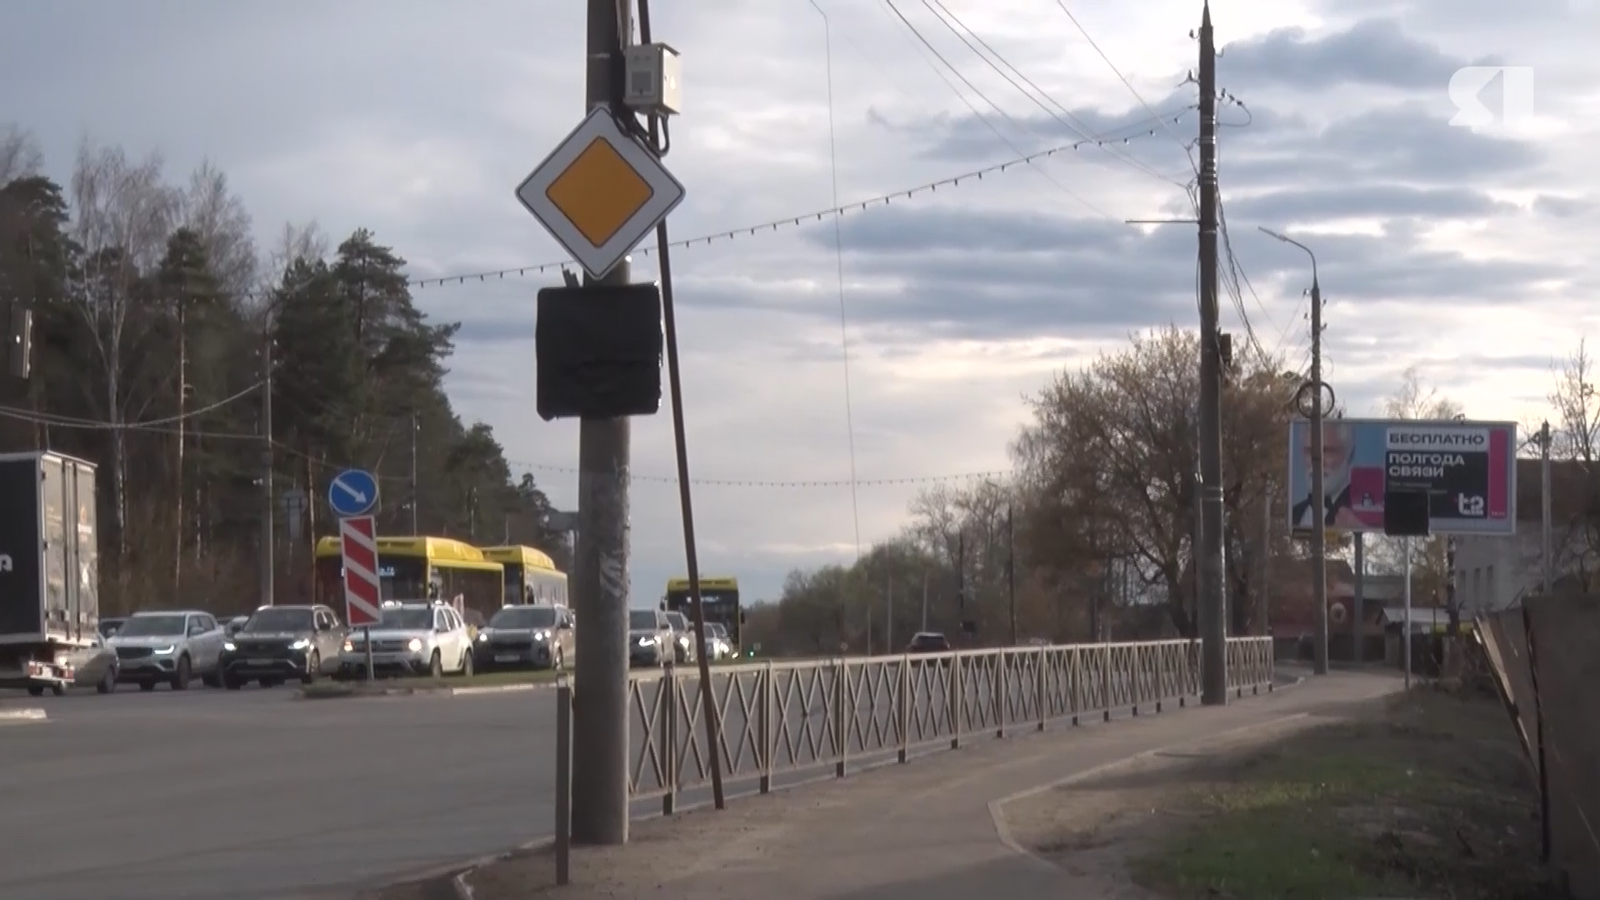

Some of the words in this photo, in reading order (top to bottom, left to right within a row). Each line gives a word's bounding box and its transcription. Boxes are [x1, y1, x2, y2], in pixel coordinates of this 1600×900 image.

[1389, 432, 1485, 446] БЕСПЛАТНО
[1388, 453, 1465, 467] ПОЛГОДА
[1388, 465, 1444, 478] СВЯЗИ
